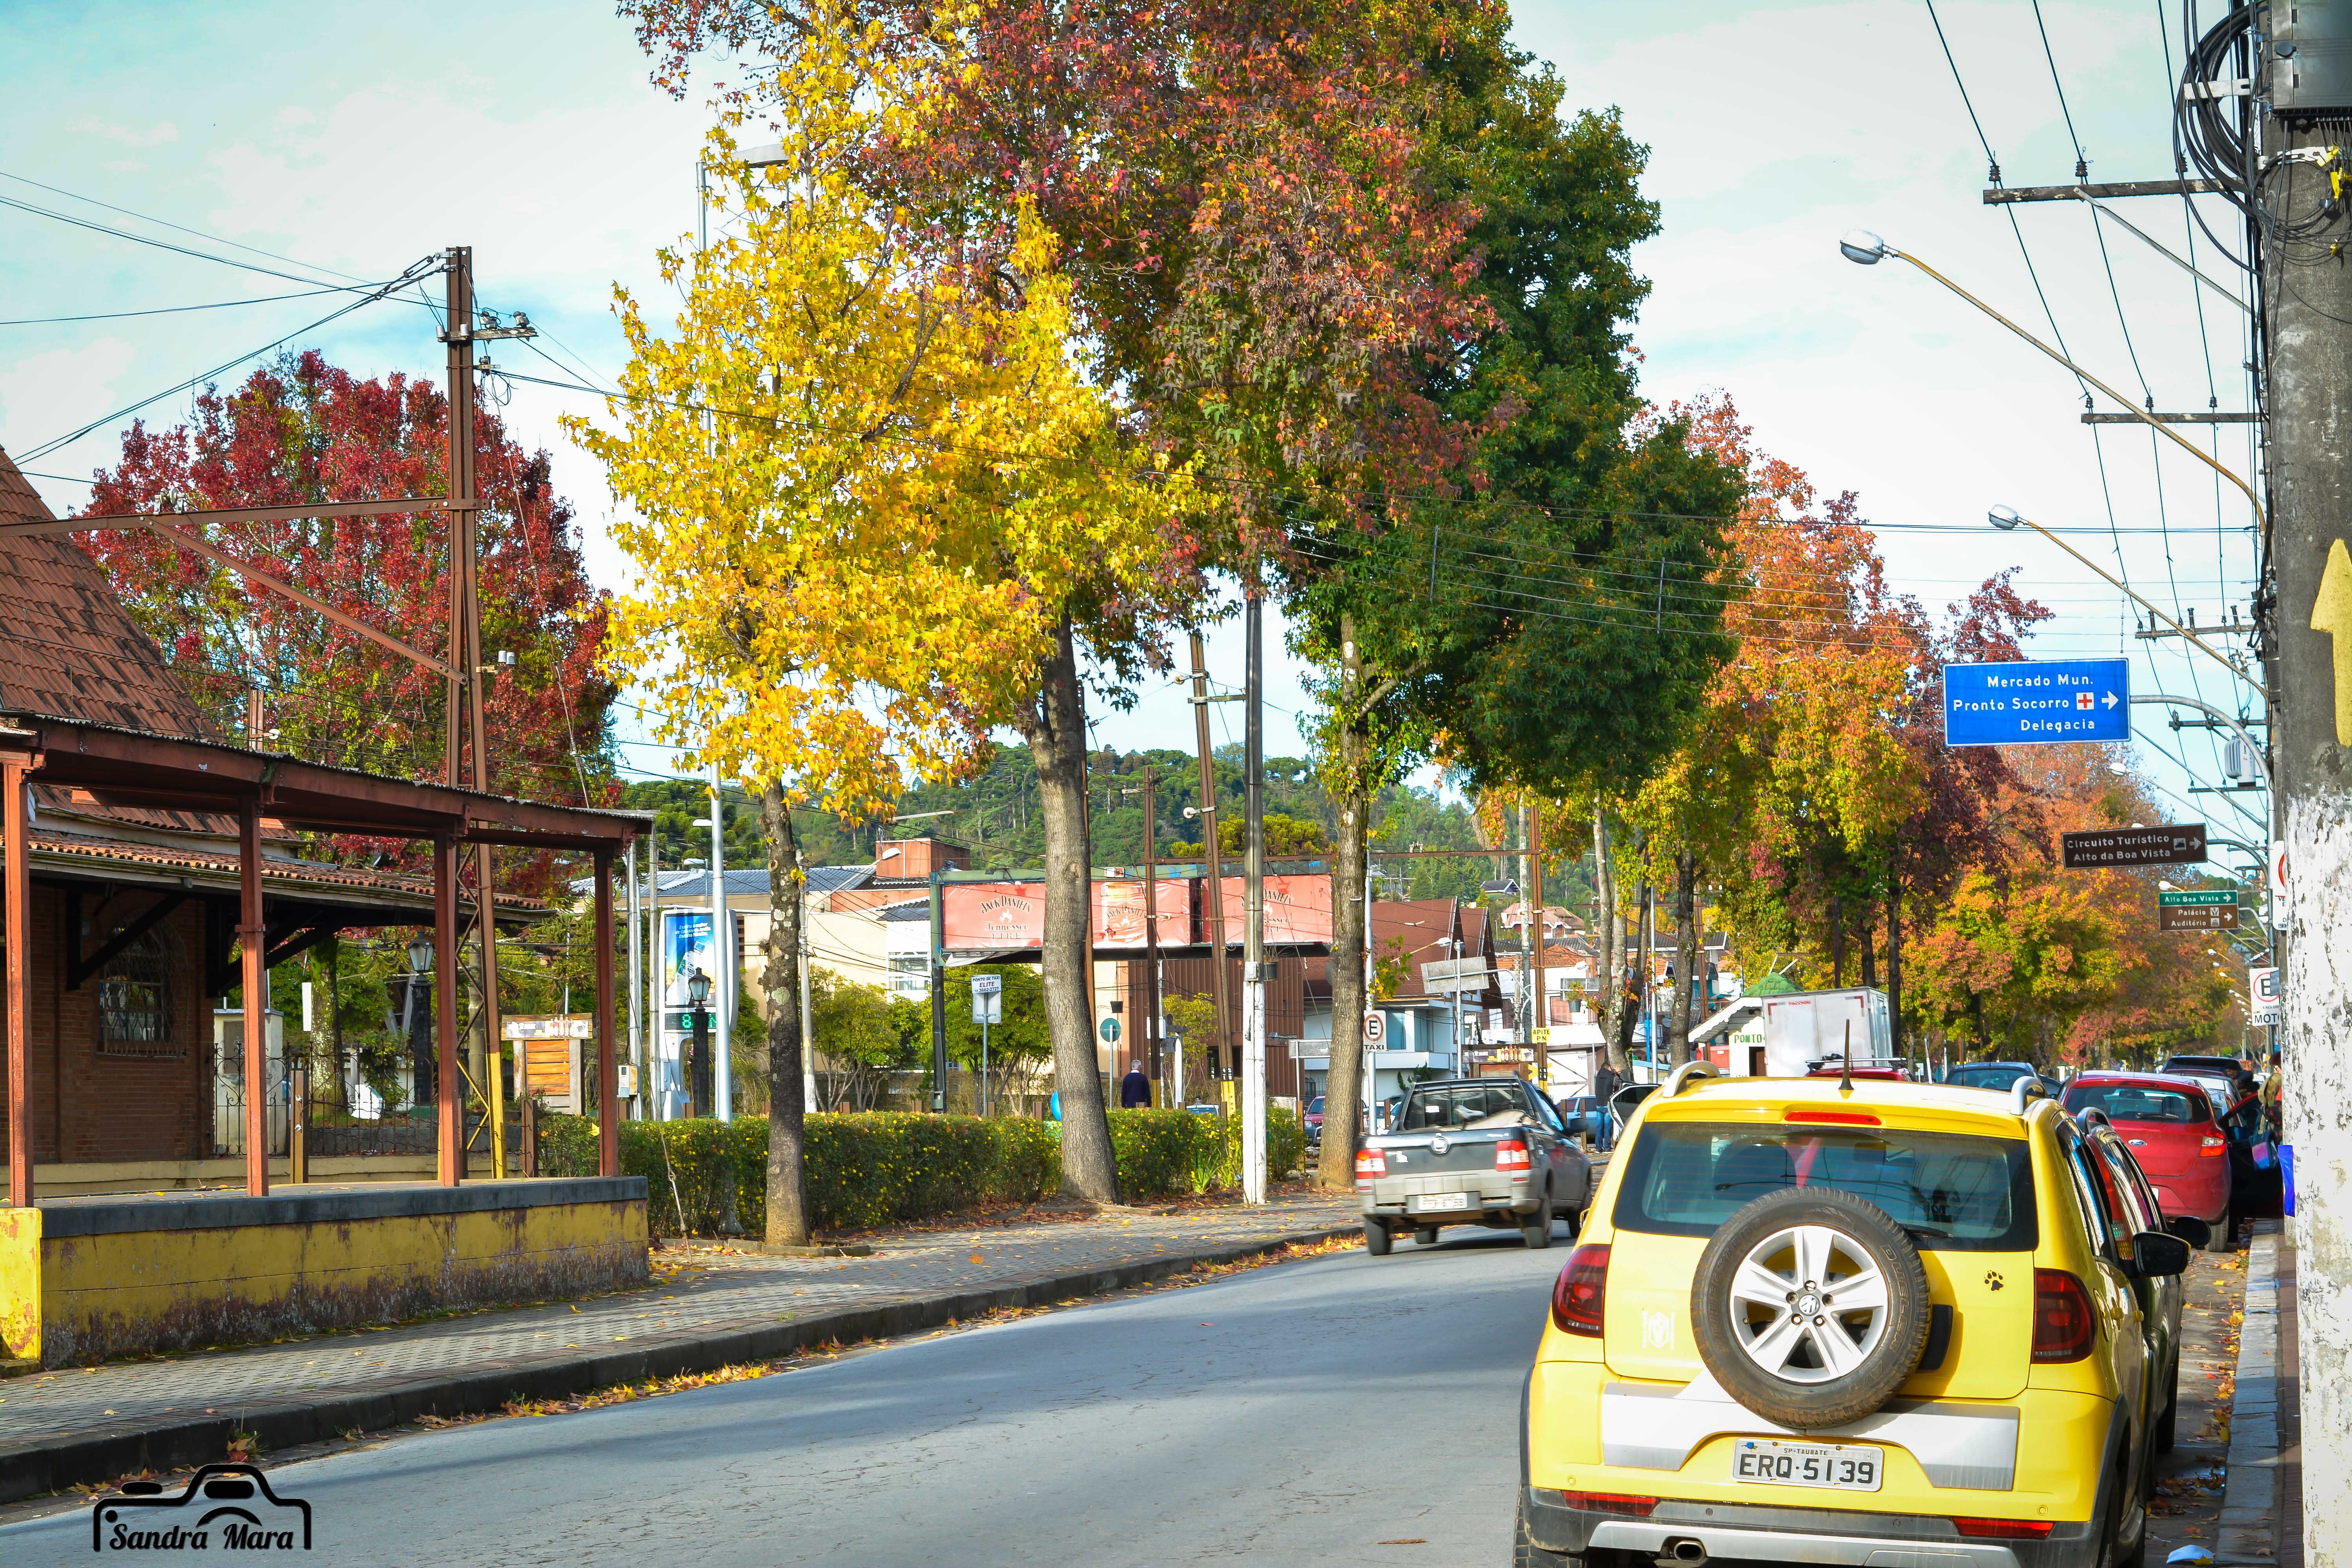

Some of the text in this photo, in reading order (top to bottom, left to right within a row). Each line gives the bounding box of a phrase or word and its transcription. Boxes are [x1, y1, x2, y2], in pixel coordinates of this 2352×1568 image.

[1987, 673, 2094, 688] Mercado Mun.
[1953, 697, 2069, 711] Pronto Socorro
[2021, 719, 2095, 733] Delegacia
[2067, 835, 2170, 849] Circuito Turístico
[2116, 851, 2137, 859] Boa
[2141, 849, 2171, 858] Vista
[985, 921, 1029, 931] Tennessee
[2255, 1013, 2279, 1023] MOT
[1369, 1020, 1378, 1035] E
[1734, 1034, 1762, 1044] PONTO
